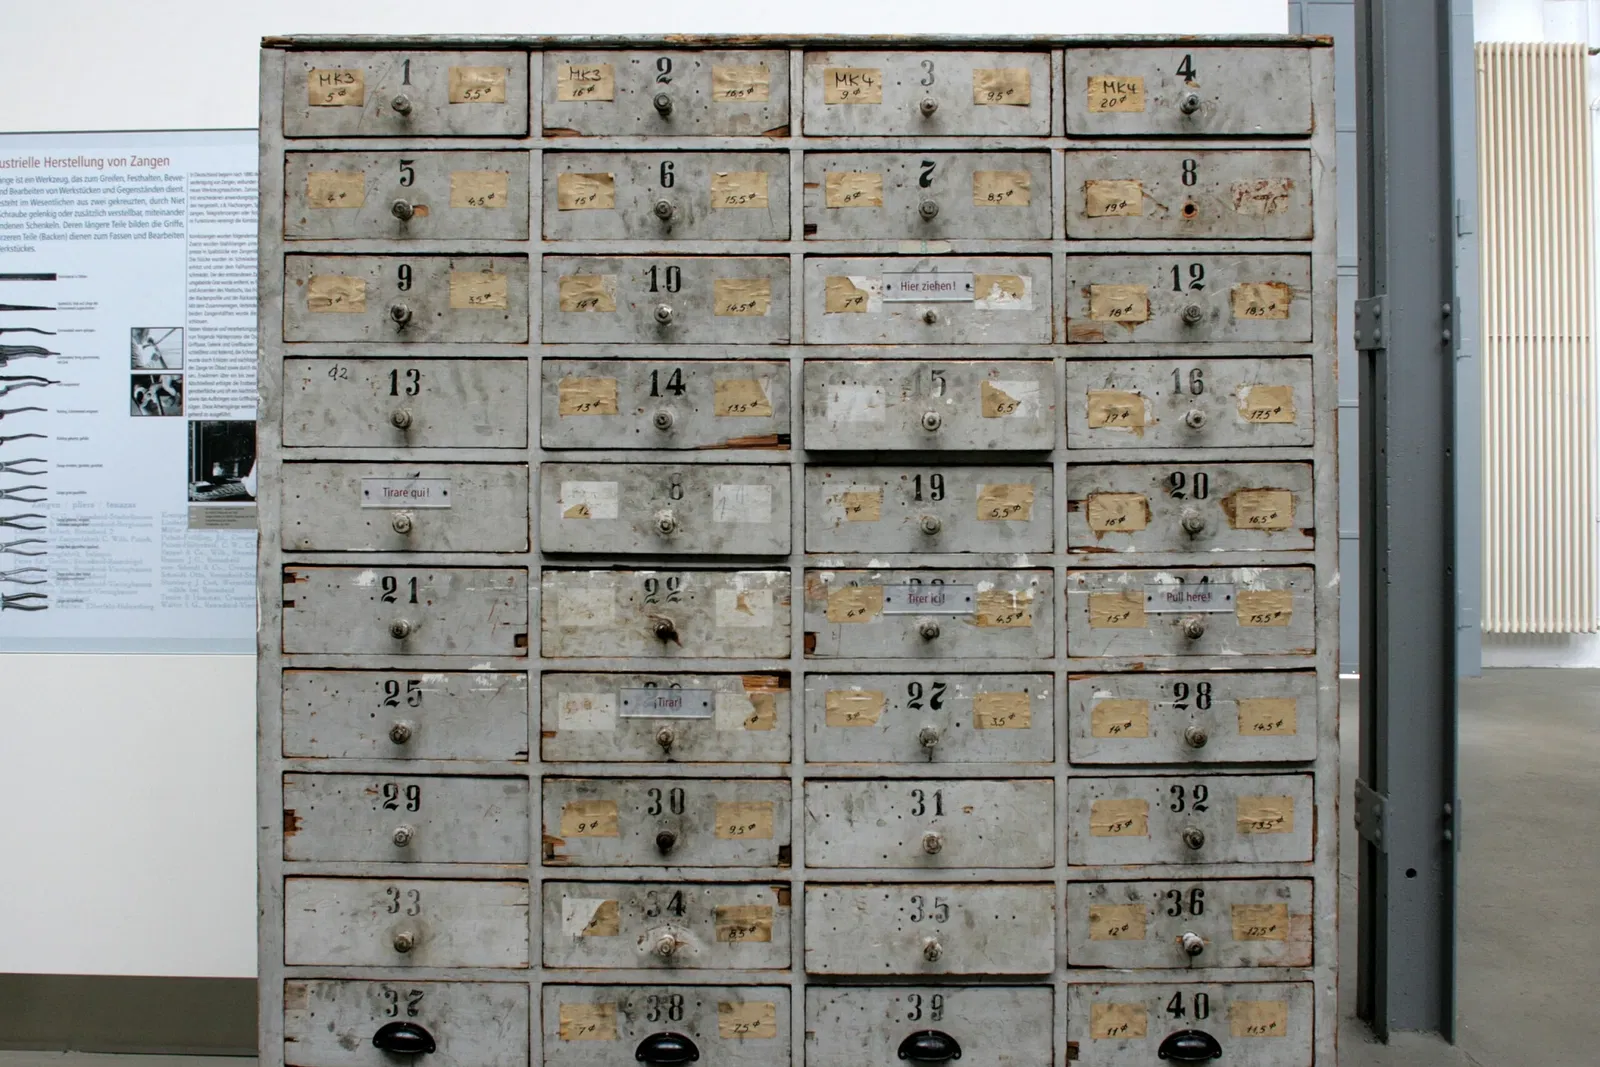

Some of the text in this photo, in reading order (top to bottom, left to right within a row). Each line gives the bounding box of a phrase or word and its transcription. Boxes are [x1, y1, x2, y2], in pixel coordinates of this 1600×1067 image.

[319, 73, 355, 86] MK3
[401, 59, 411, 85] 1
[569, 67, 601, 81] MK3
[656, 57, 672, 84] 2
[835, 72, 873, 87] MK4
[921, 60, 935, 86] 3
[1176, 54, 1196, 81] 4
[1103, 81, 1136, 94] MK4
[44, 156, 104, 169] Herstellung
[107, 158, 126, 167] von
[131, 156, 170, 169] Zangen
[399, 160, 415, 187] 5
[660, 161, 675, 187] 6
[919, 161, 936, 187] 7
[1182, 159, 1197, 186] 8
[398, 264, 412, 291] 9
[646, 266, 681, 293] 10
[900, 281, 956, 291] Hier ziehen!
[1171, 263, 1205, 291] 12
[389, 369, 421, 396] 13
[650, 368, 686, 397] 14
[1171, 368, 1204, 395] 16
[383, 487, 429, 498] Tirare qui!
[912, 474, 945, 501] 19
[1170, 472, 1208, 500] 20
[381, 576, 418, 604] 21
[644, 577, 682, 604] 22
[908, 593, 945, 604] Tirer ici!
[1166, 592, 1211, 602] Pull here!
[384, 680, 423, 707] 25
[654, 697, 682, 709] ¡Tirar!
[907, 682, 947, 710] 27
[1173, 682, 1212, 710] 28
[383, 783, 421, 812] 29
[648, 788, 685, 815] 30
[911, 789, 944, 816] 31
[1170, 785, 1209, 813] 32
[386, 887, 421, 916] 33
[647, 891, 686, 917] 34
[910, 895, 950, 923] 35
[1167, 889, 1205, 917] 36
[385, 990, 424, 1017] 37
[647, 994, 684, 1022] 38
[908, 994, 944, 1021] 39
[1166, 992, 1209, 1019] 40
